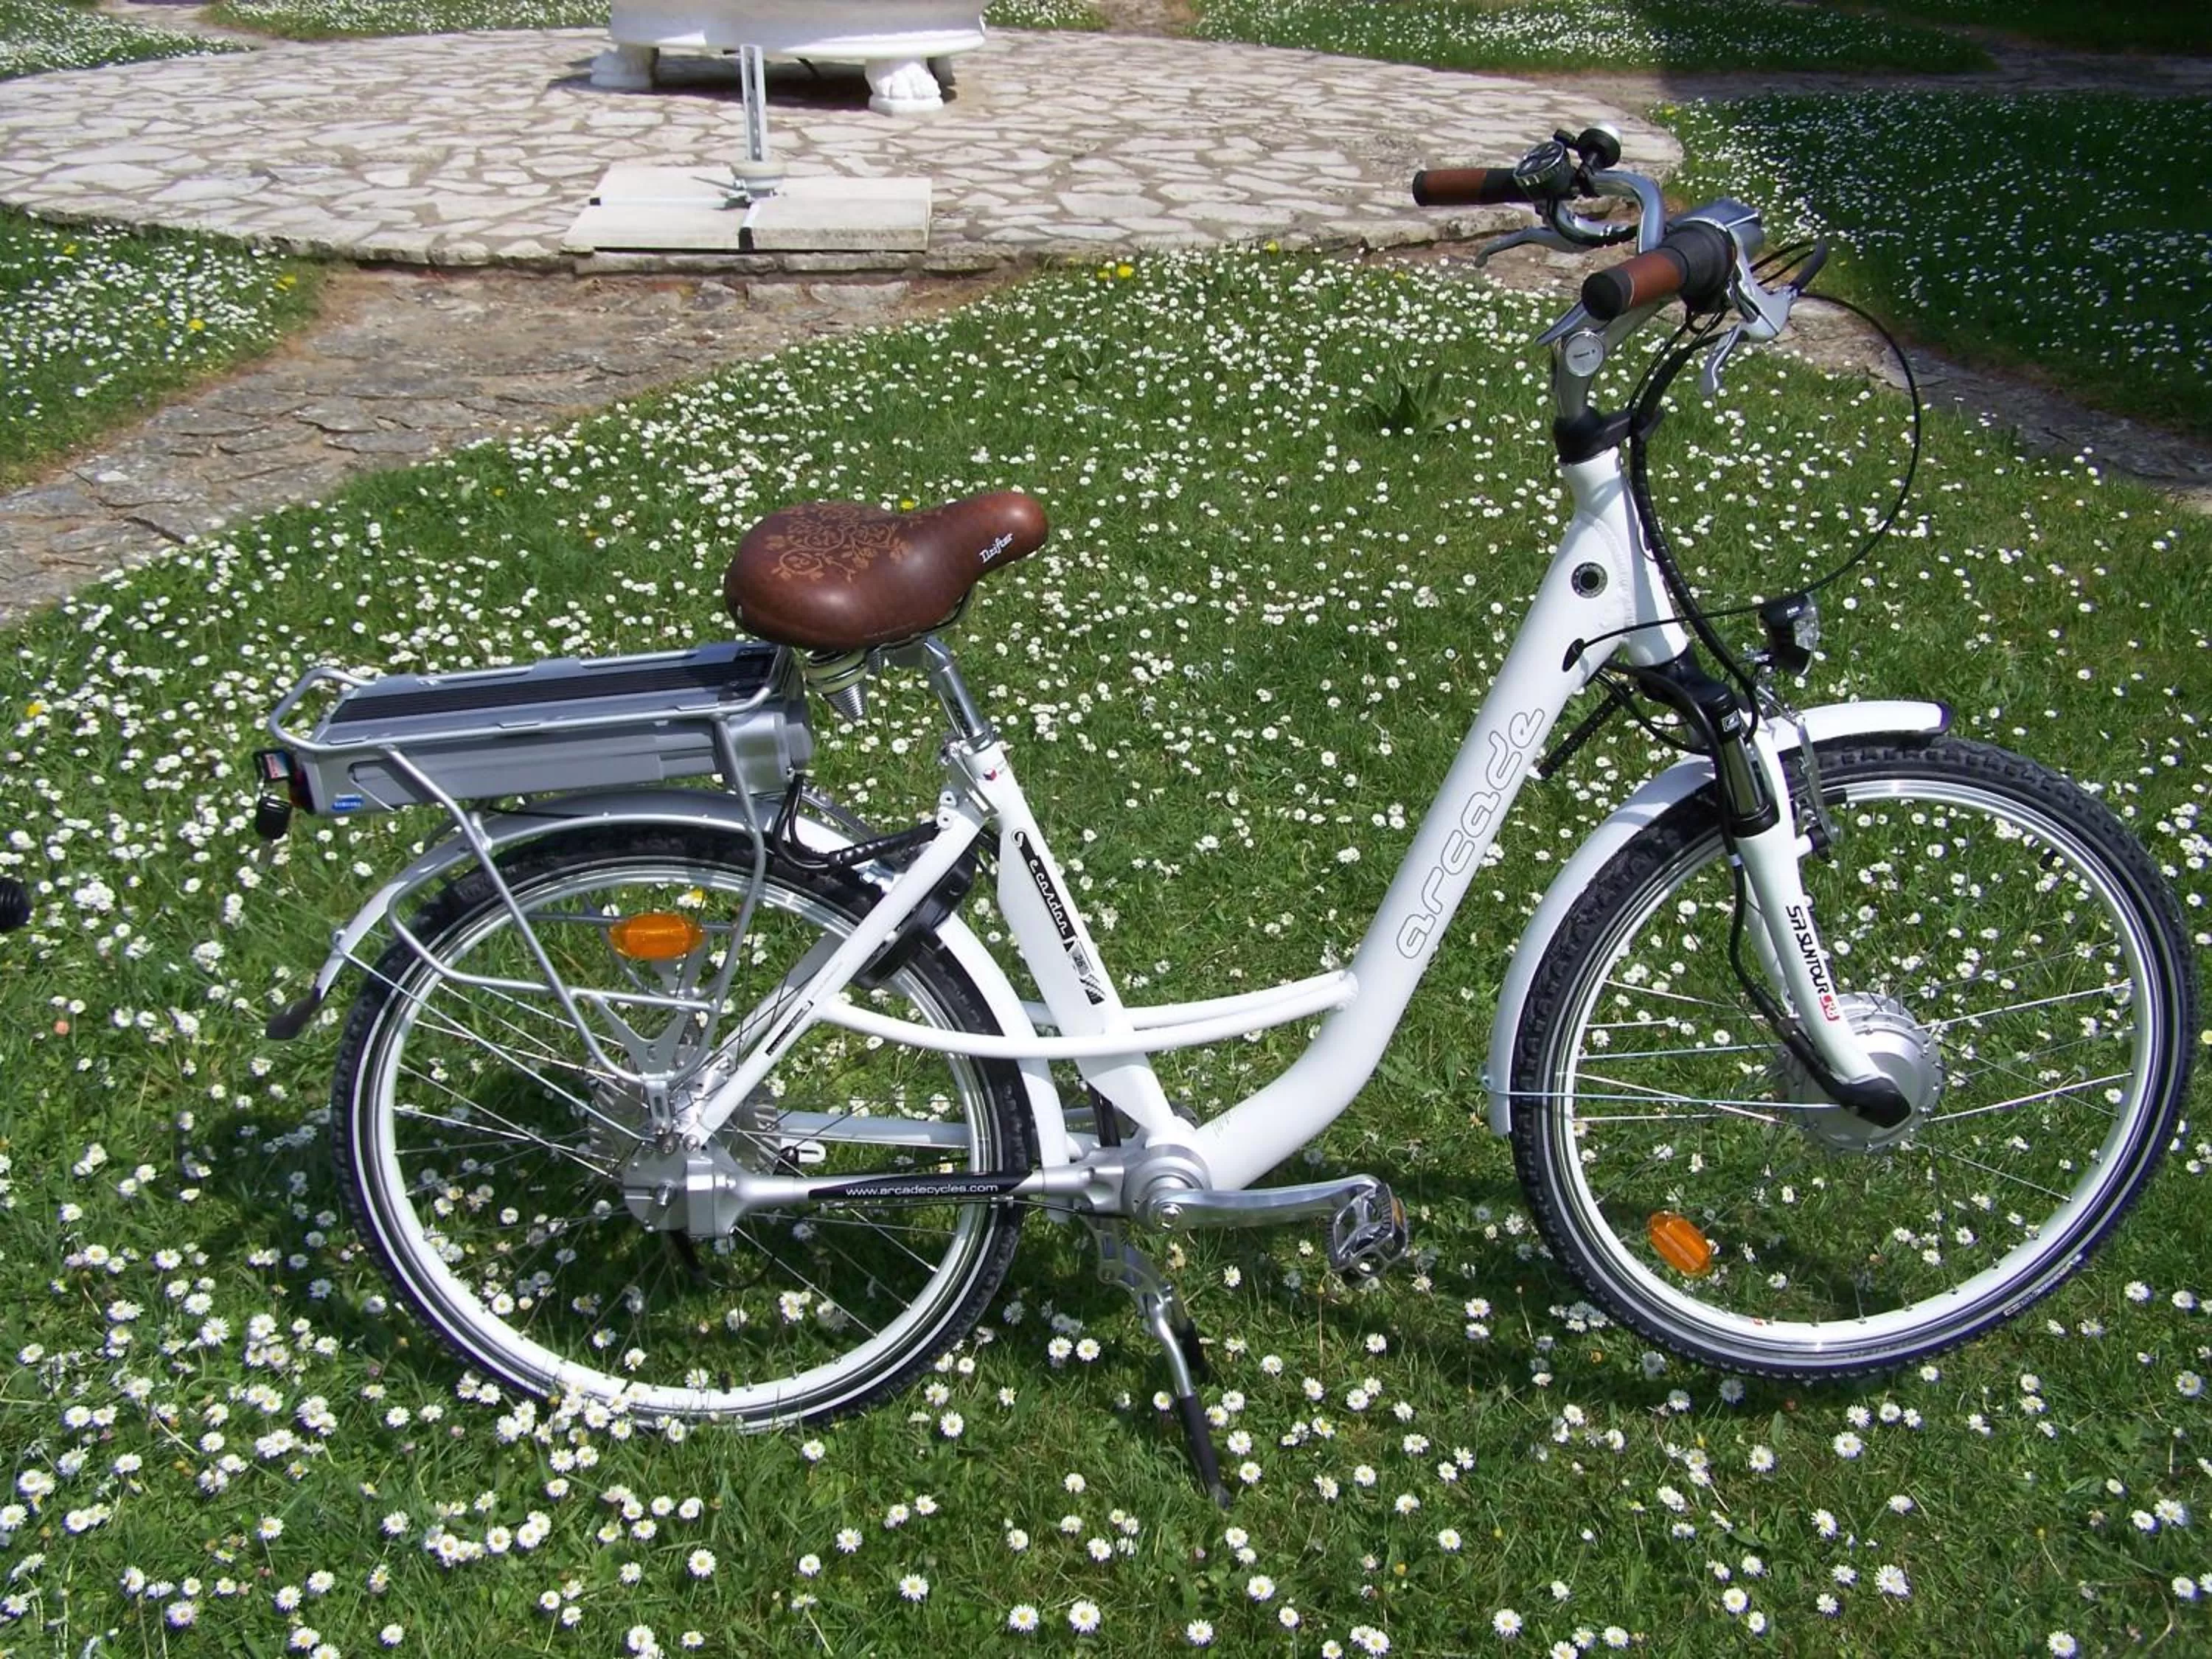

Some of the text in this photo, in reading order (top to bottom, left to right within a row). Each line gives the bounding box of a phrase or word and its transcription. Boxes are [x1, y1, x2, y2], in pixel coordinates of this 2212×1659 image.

[1397, 708, 1545, 959] arcade
[1796, 932, 1829, 994] SUNTOUR
[846, 1183, 999, 1197] www.arcadecycles.com
